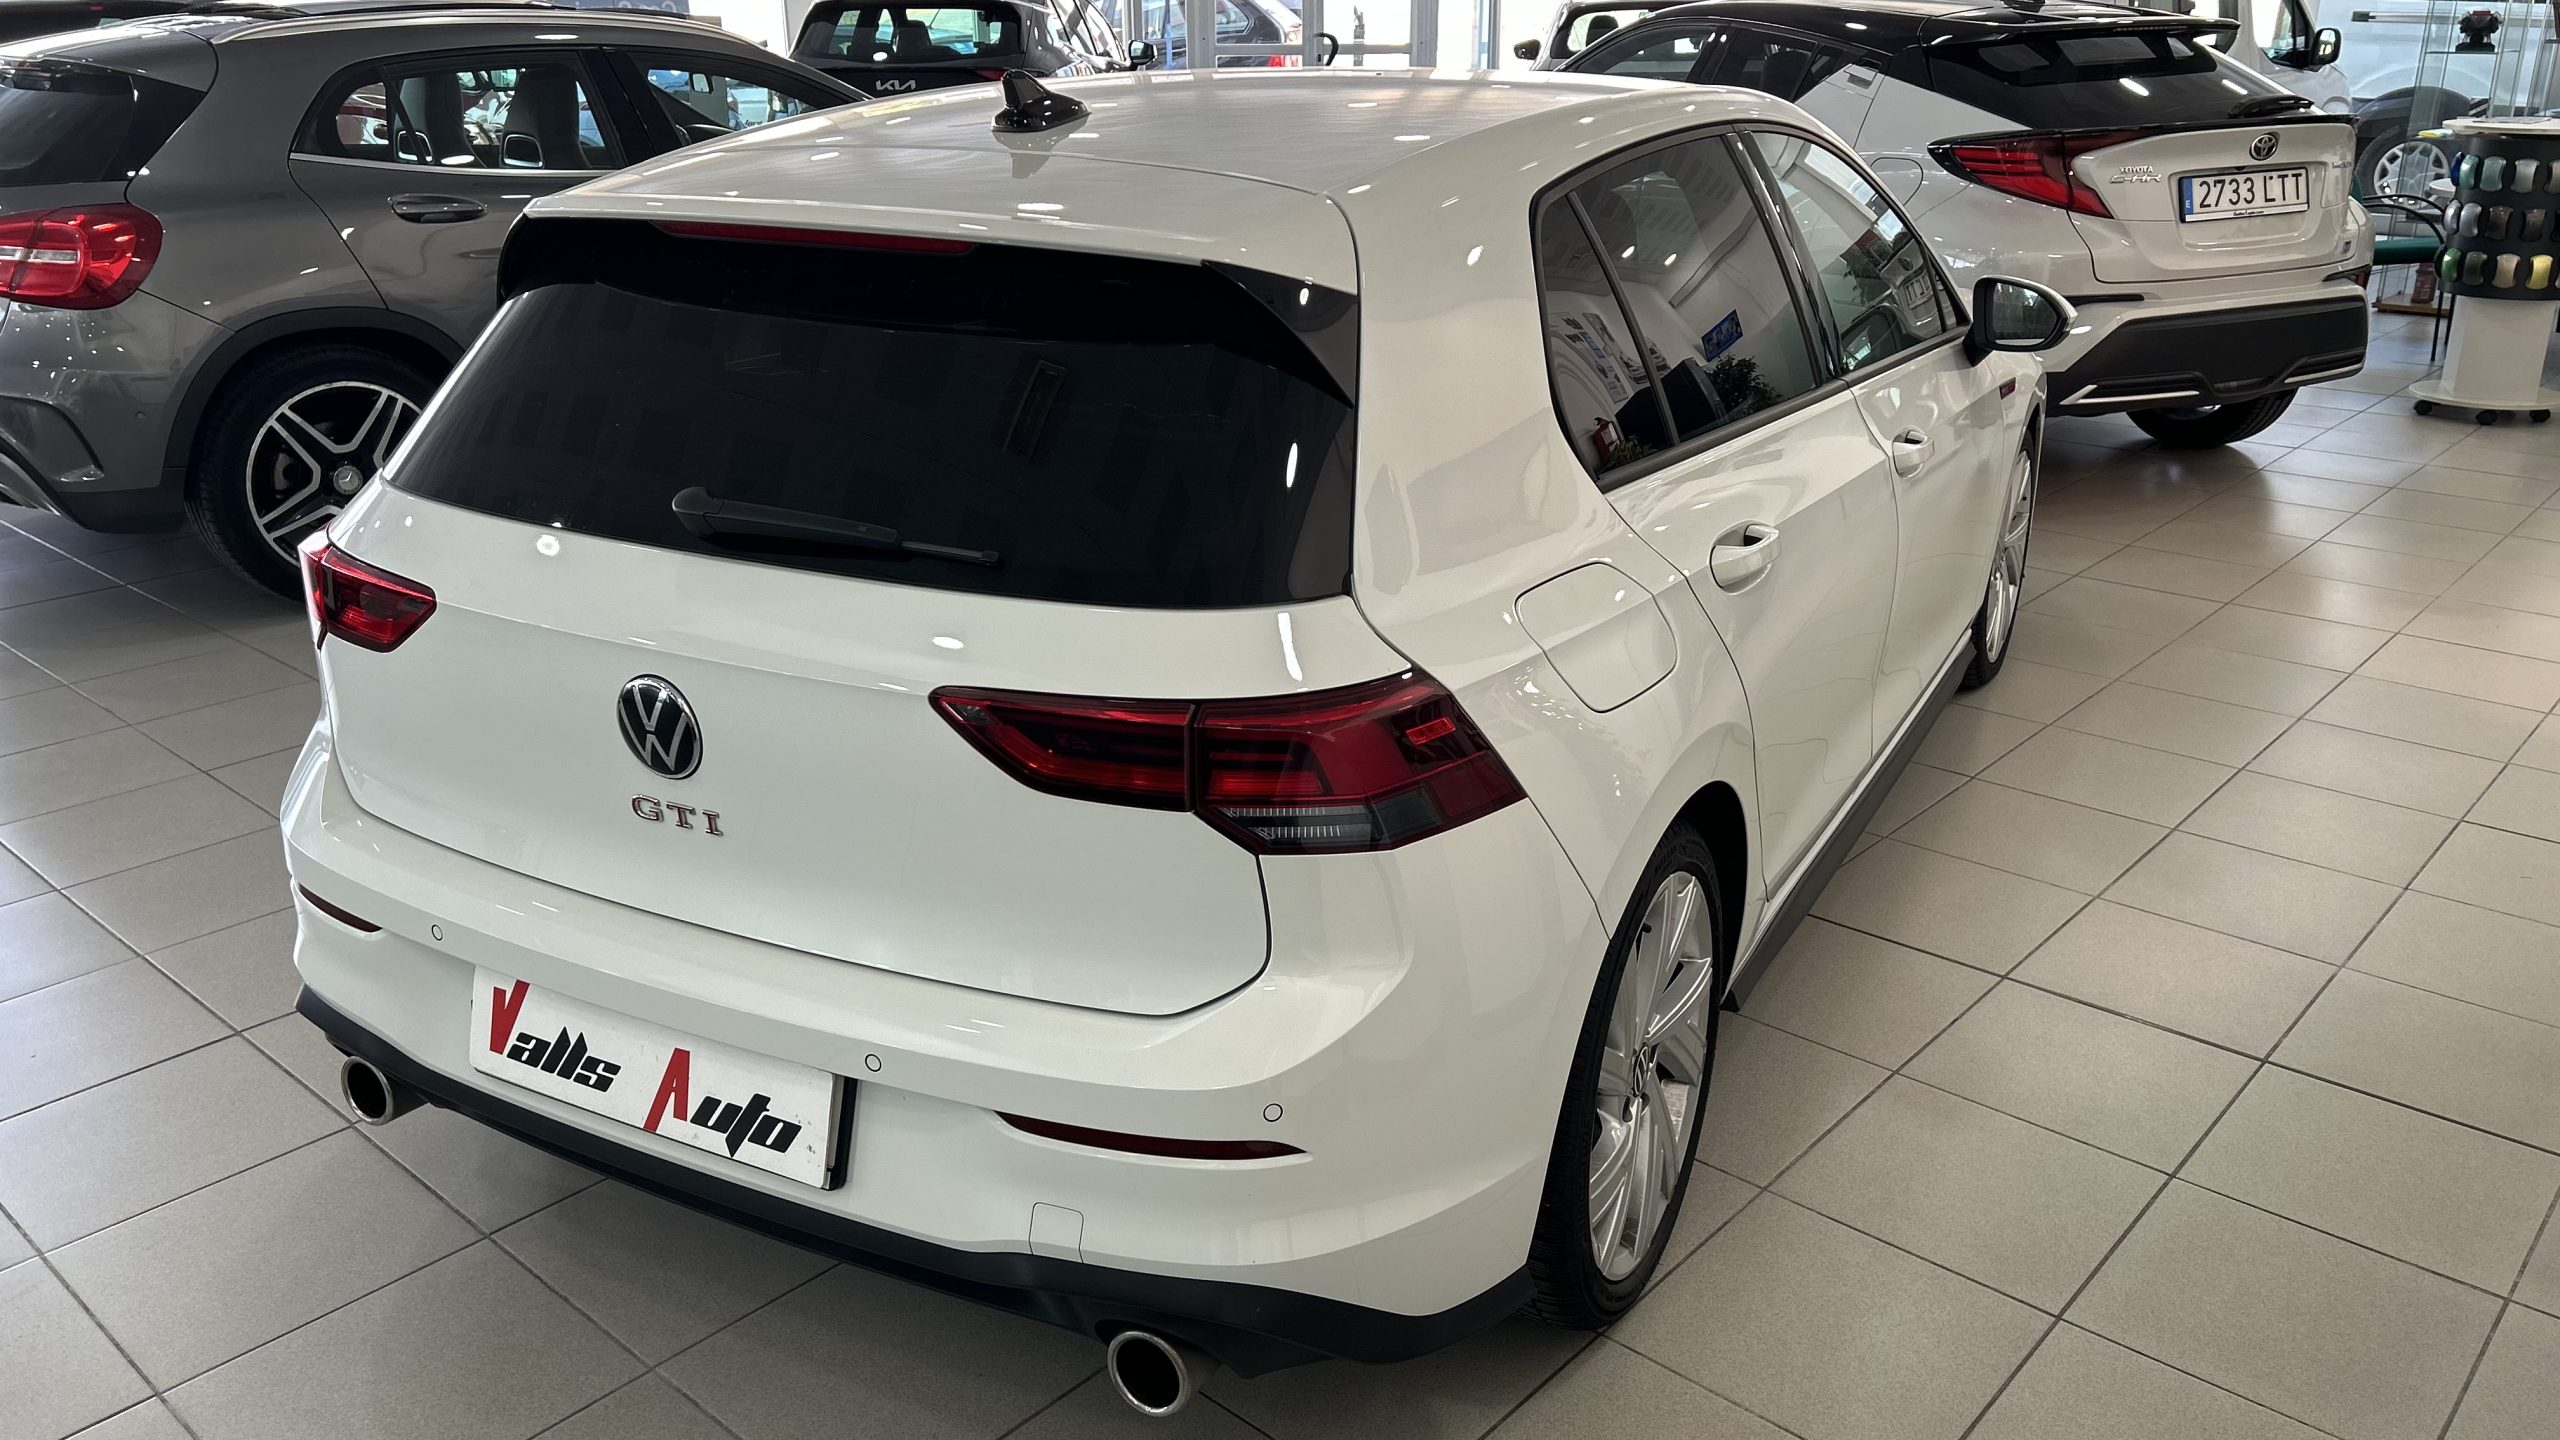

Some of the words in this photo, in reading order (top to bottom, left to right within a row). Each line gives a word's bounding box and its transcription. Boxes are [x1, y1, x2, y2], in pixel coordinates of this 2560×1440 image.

[875, 79, 917, 90] KIA
[2109, 173, 2162, 184] C-HR
[2119, 165, 2154, 174] TOYOTA
[2199, 176, 2256, 209] 2733
[2263, 173, 2303, 203] LTT
[631, 793, 724, 837] GTI
[489, 979, 622, 1093] Valls
[642, 1047, 803, 1159] Auto
